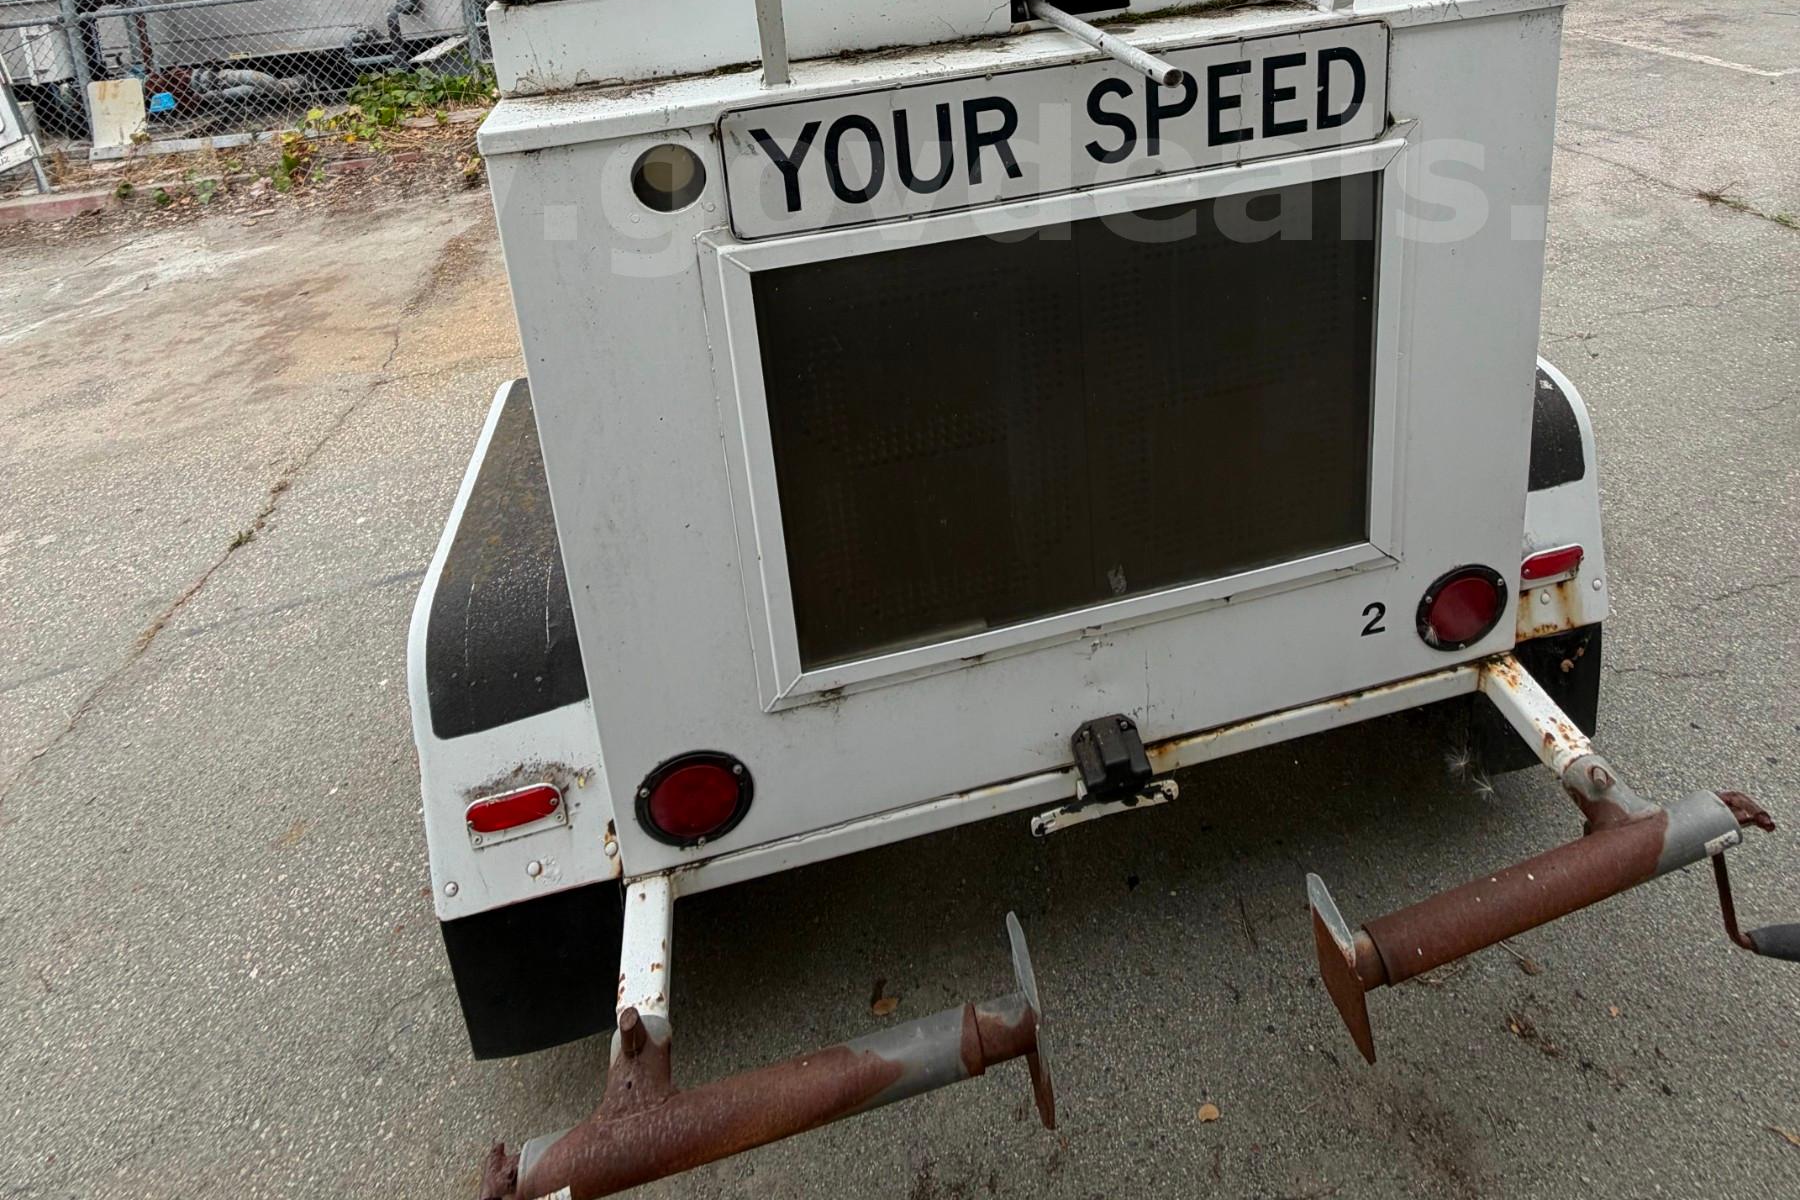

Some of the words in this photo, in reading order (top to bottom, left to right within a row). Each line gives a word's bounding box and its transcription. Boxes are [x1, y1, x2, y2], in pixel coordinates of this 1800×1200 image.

[748, 96, 1022, 213] YOUR
[1084, 44, 1368, 166] SPEED
[1360, 601, 1387, 638] 2
